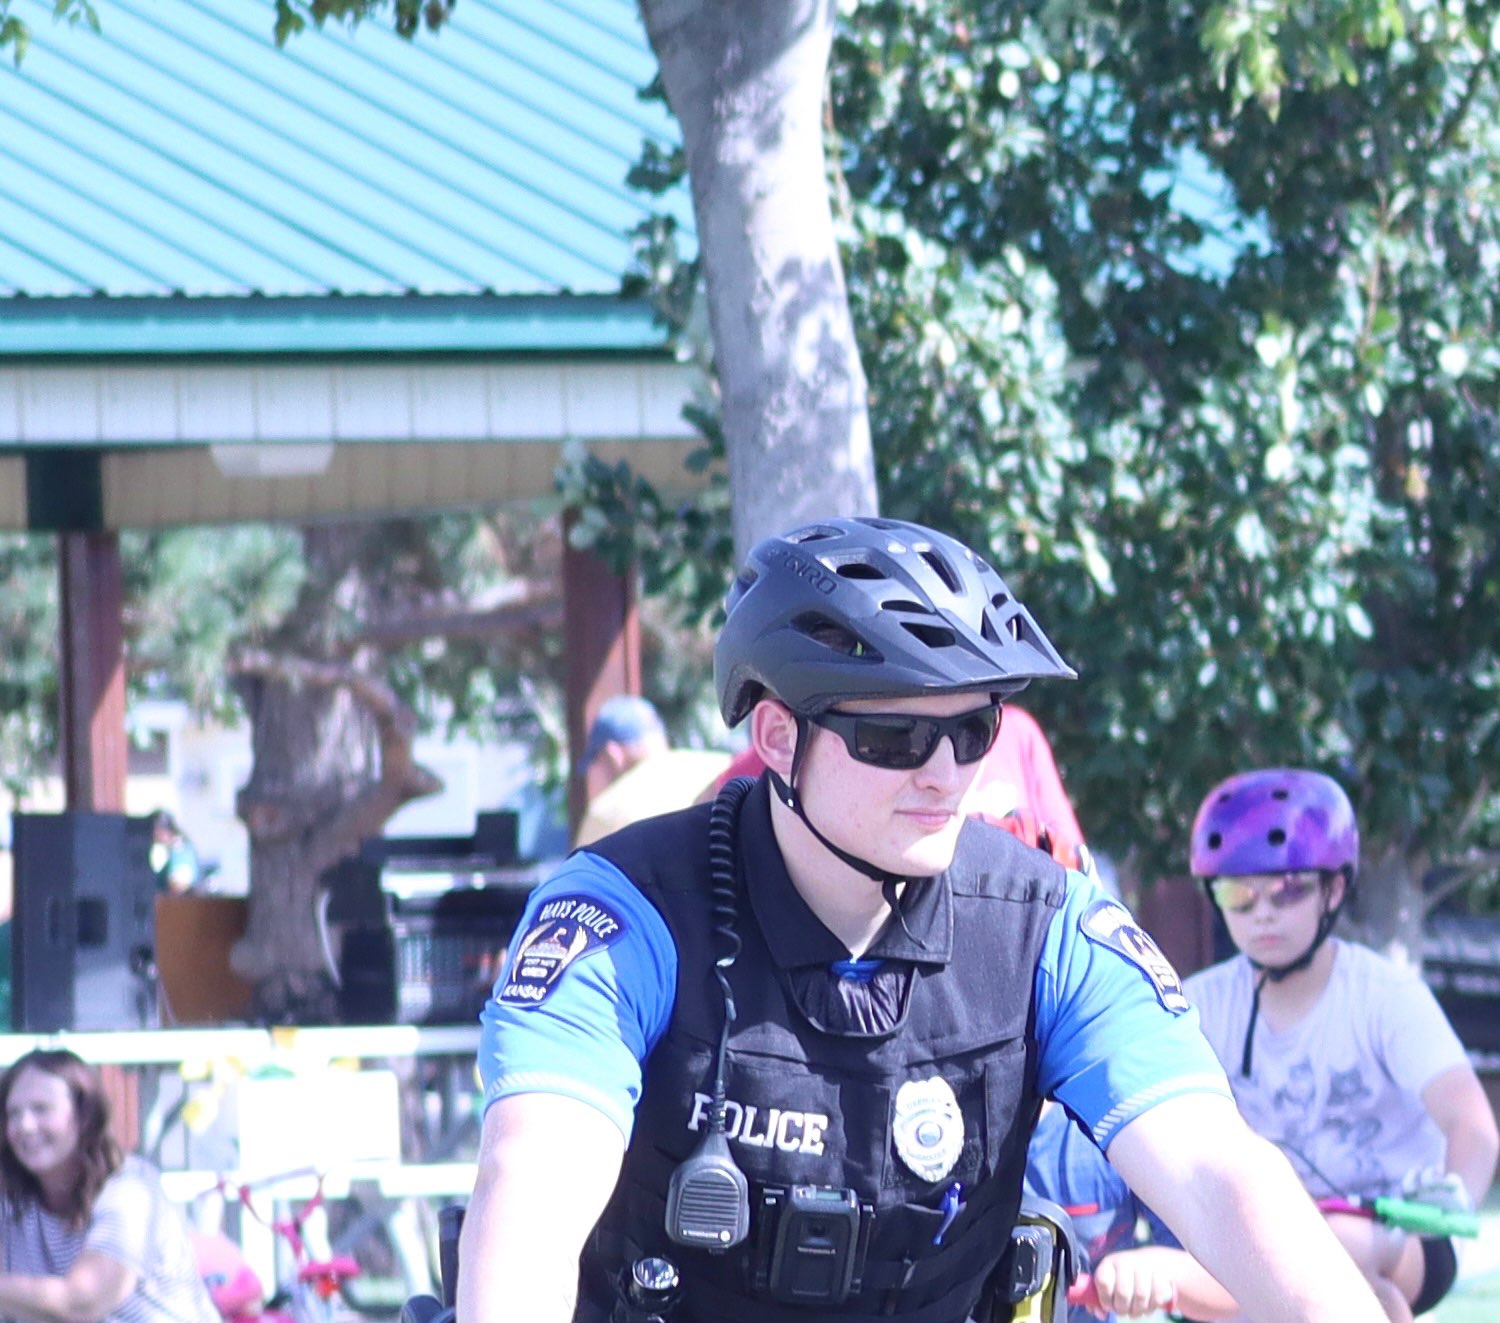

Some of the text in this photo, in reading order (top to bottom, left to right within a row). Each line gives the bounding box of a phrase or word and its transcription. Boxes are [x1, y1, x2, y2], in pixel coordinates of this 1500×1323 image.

[539, 899, 619, 939] HAYS POLICE
[503, 983, 547, 1001] KANSAS
[687, 1091, 829, 1157] POLICE
